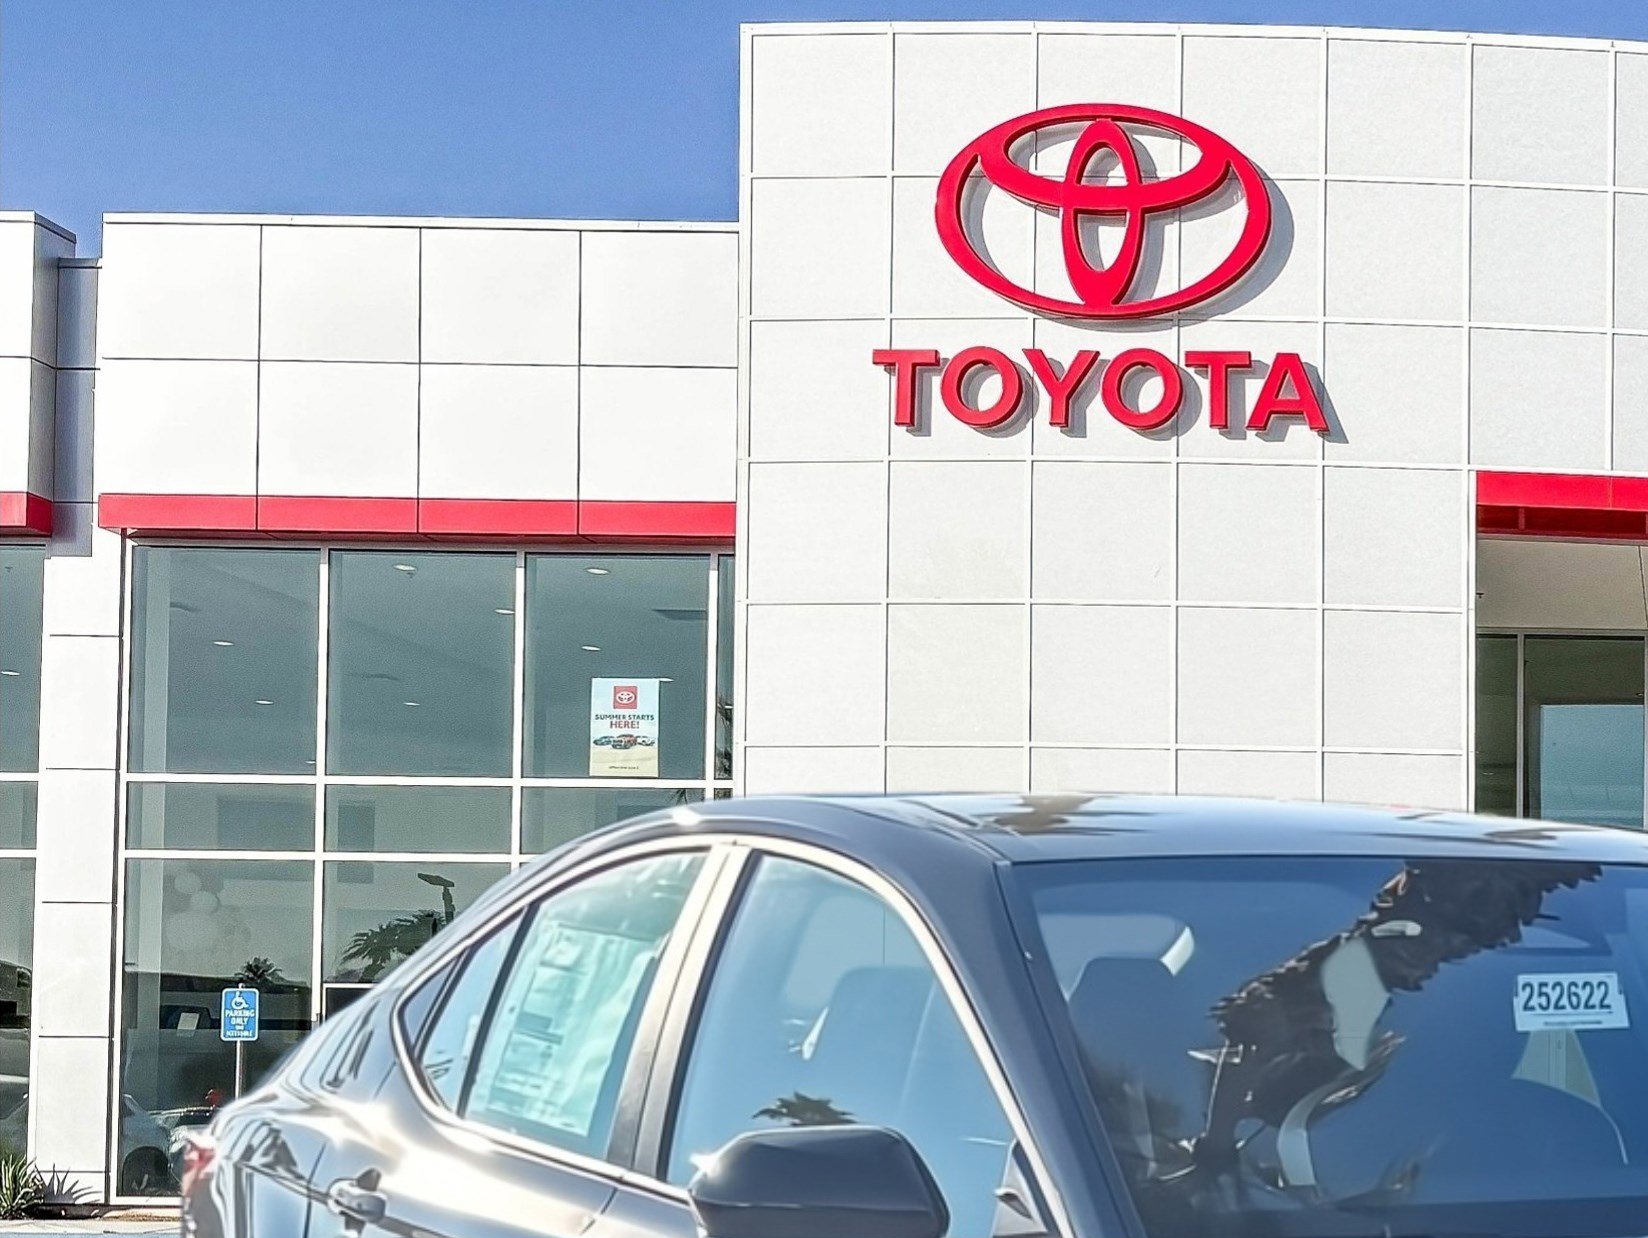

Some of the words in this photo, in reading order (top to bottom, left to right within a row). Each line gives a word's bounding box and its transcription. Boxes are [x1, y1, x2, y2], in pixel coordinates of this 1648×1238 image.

[872, 346, 1331, 433] TOYOTA
[609, 721, 640, 729] HERE!
[1521, 981, 1612, 1012] 252622
[225, 1009, 255, 1017] PARKING
[231, 1017, 249, 1025] ONLY
